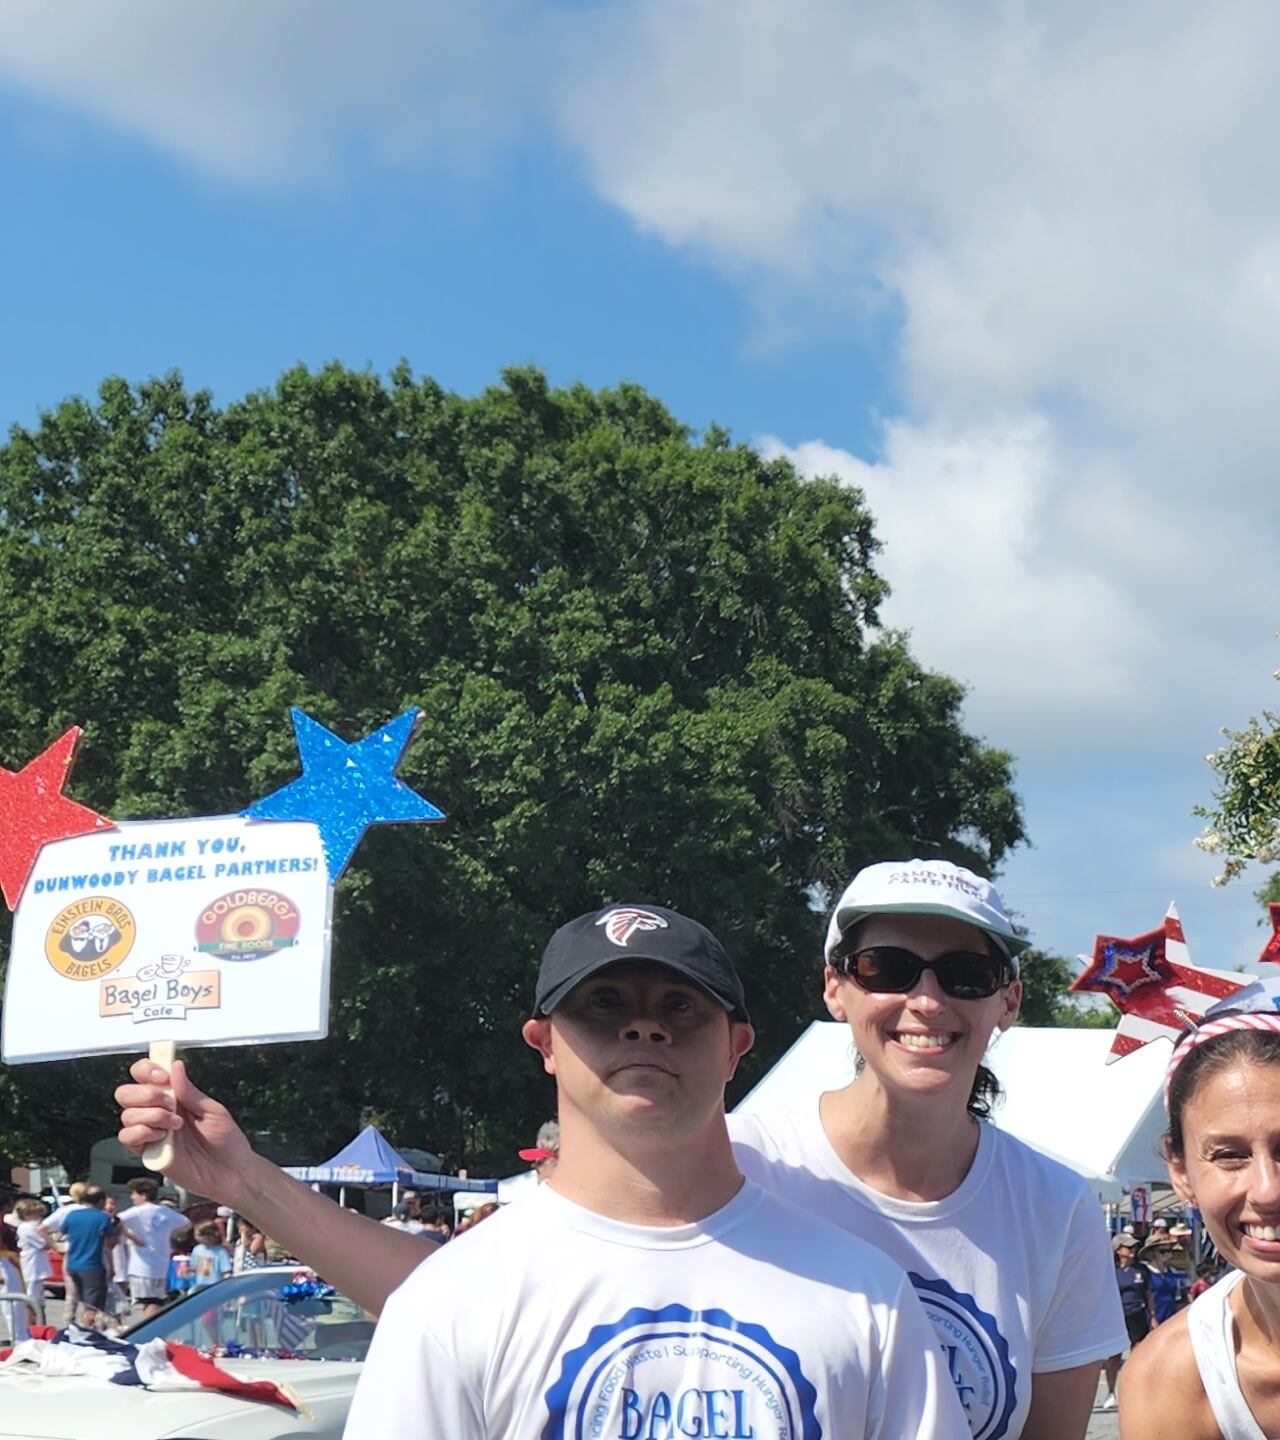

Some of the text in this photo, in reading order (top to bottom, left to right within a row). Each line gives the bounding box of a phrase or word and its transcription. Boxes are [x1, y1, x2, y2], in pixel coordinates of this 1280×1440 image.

[109, 837, 246, 862] THANK YOU,
[34, 858, 318, 894] DUNWOODY BAGEL PARTNERS!
[52, 899, 131, 936] EINSTEIN BROS
[202, 891, 296, 924] GOLDBERGS
[65, 959, 112, 978] BAGELS
[104, 979, 213, 1008] Bagel Boys
[143, 1006, 173, 1018] Cafe
[333, 1168, 375, 1182] TROOPS
[599, 1366, 625, 1401] Food
[621, 1349, 662, 1370] Waste
[752, 1375, 785, 1423] Hunger
